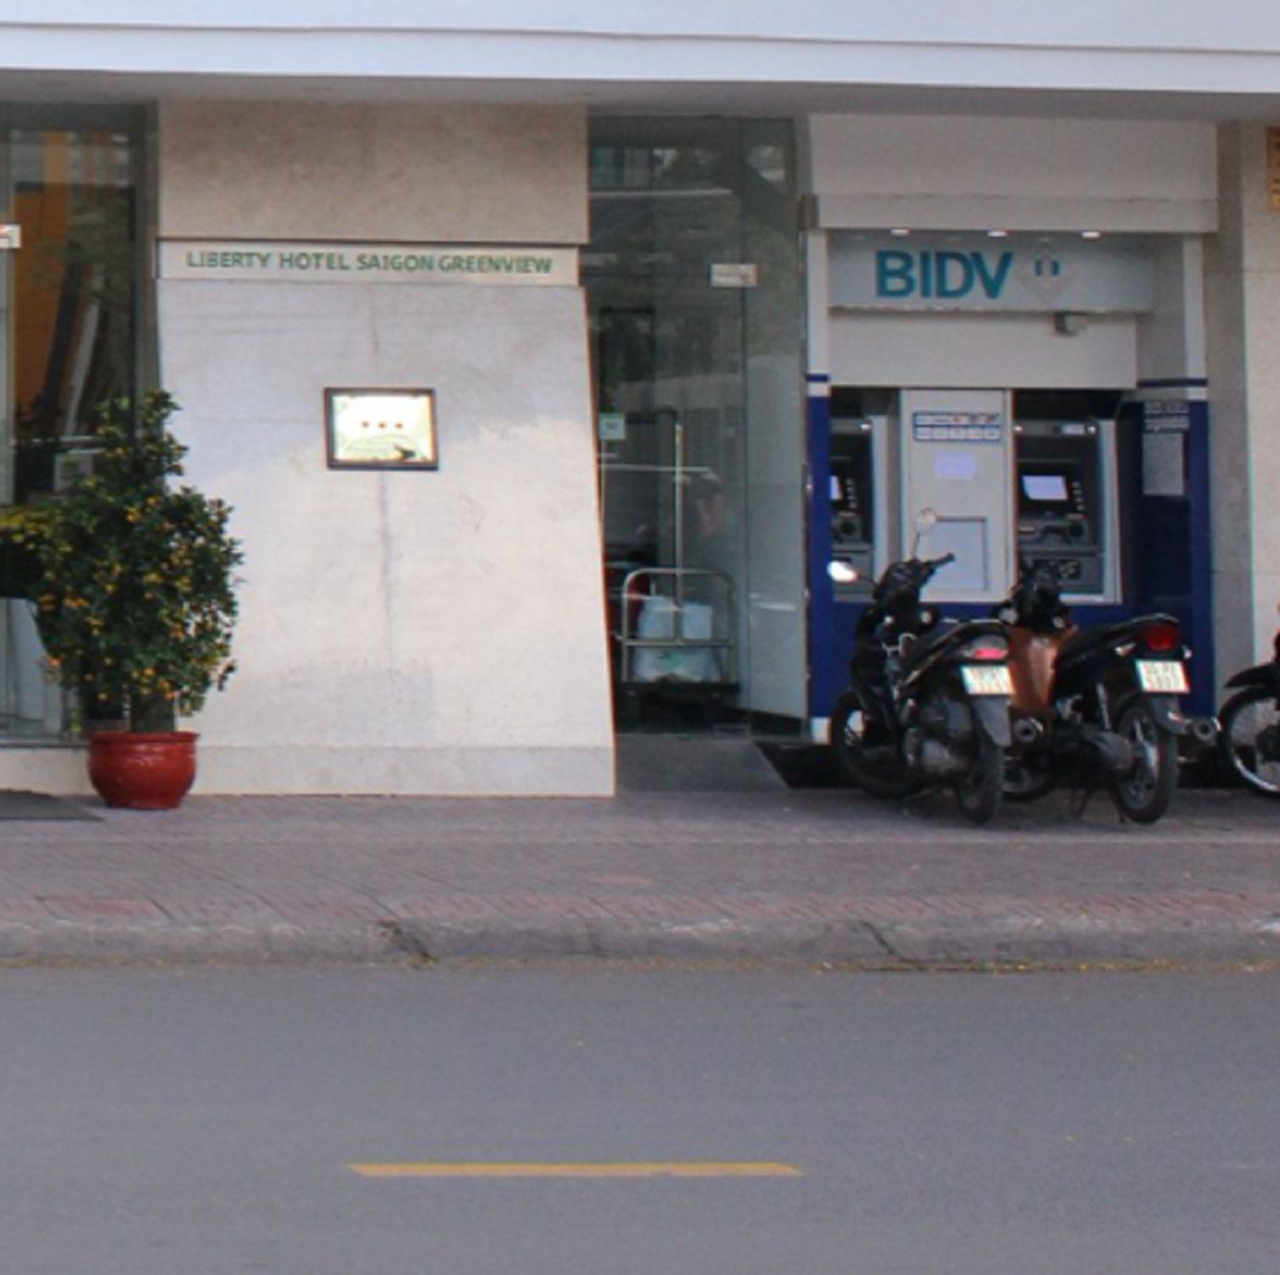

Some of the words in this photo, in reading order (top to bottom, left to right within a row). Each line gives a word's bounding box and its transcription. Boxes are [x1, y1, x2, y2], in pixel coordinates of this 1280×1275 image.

[186, 251, 271, 268] LIBERTY
[279, 252, 351, 270] HOTEL
[356, 253, 433, 271] SAIGON
[438, 254, 553, 274] GREENVIEW
[876, 250, 1013, 299] BIDV
